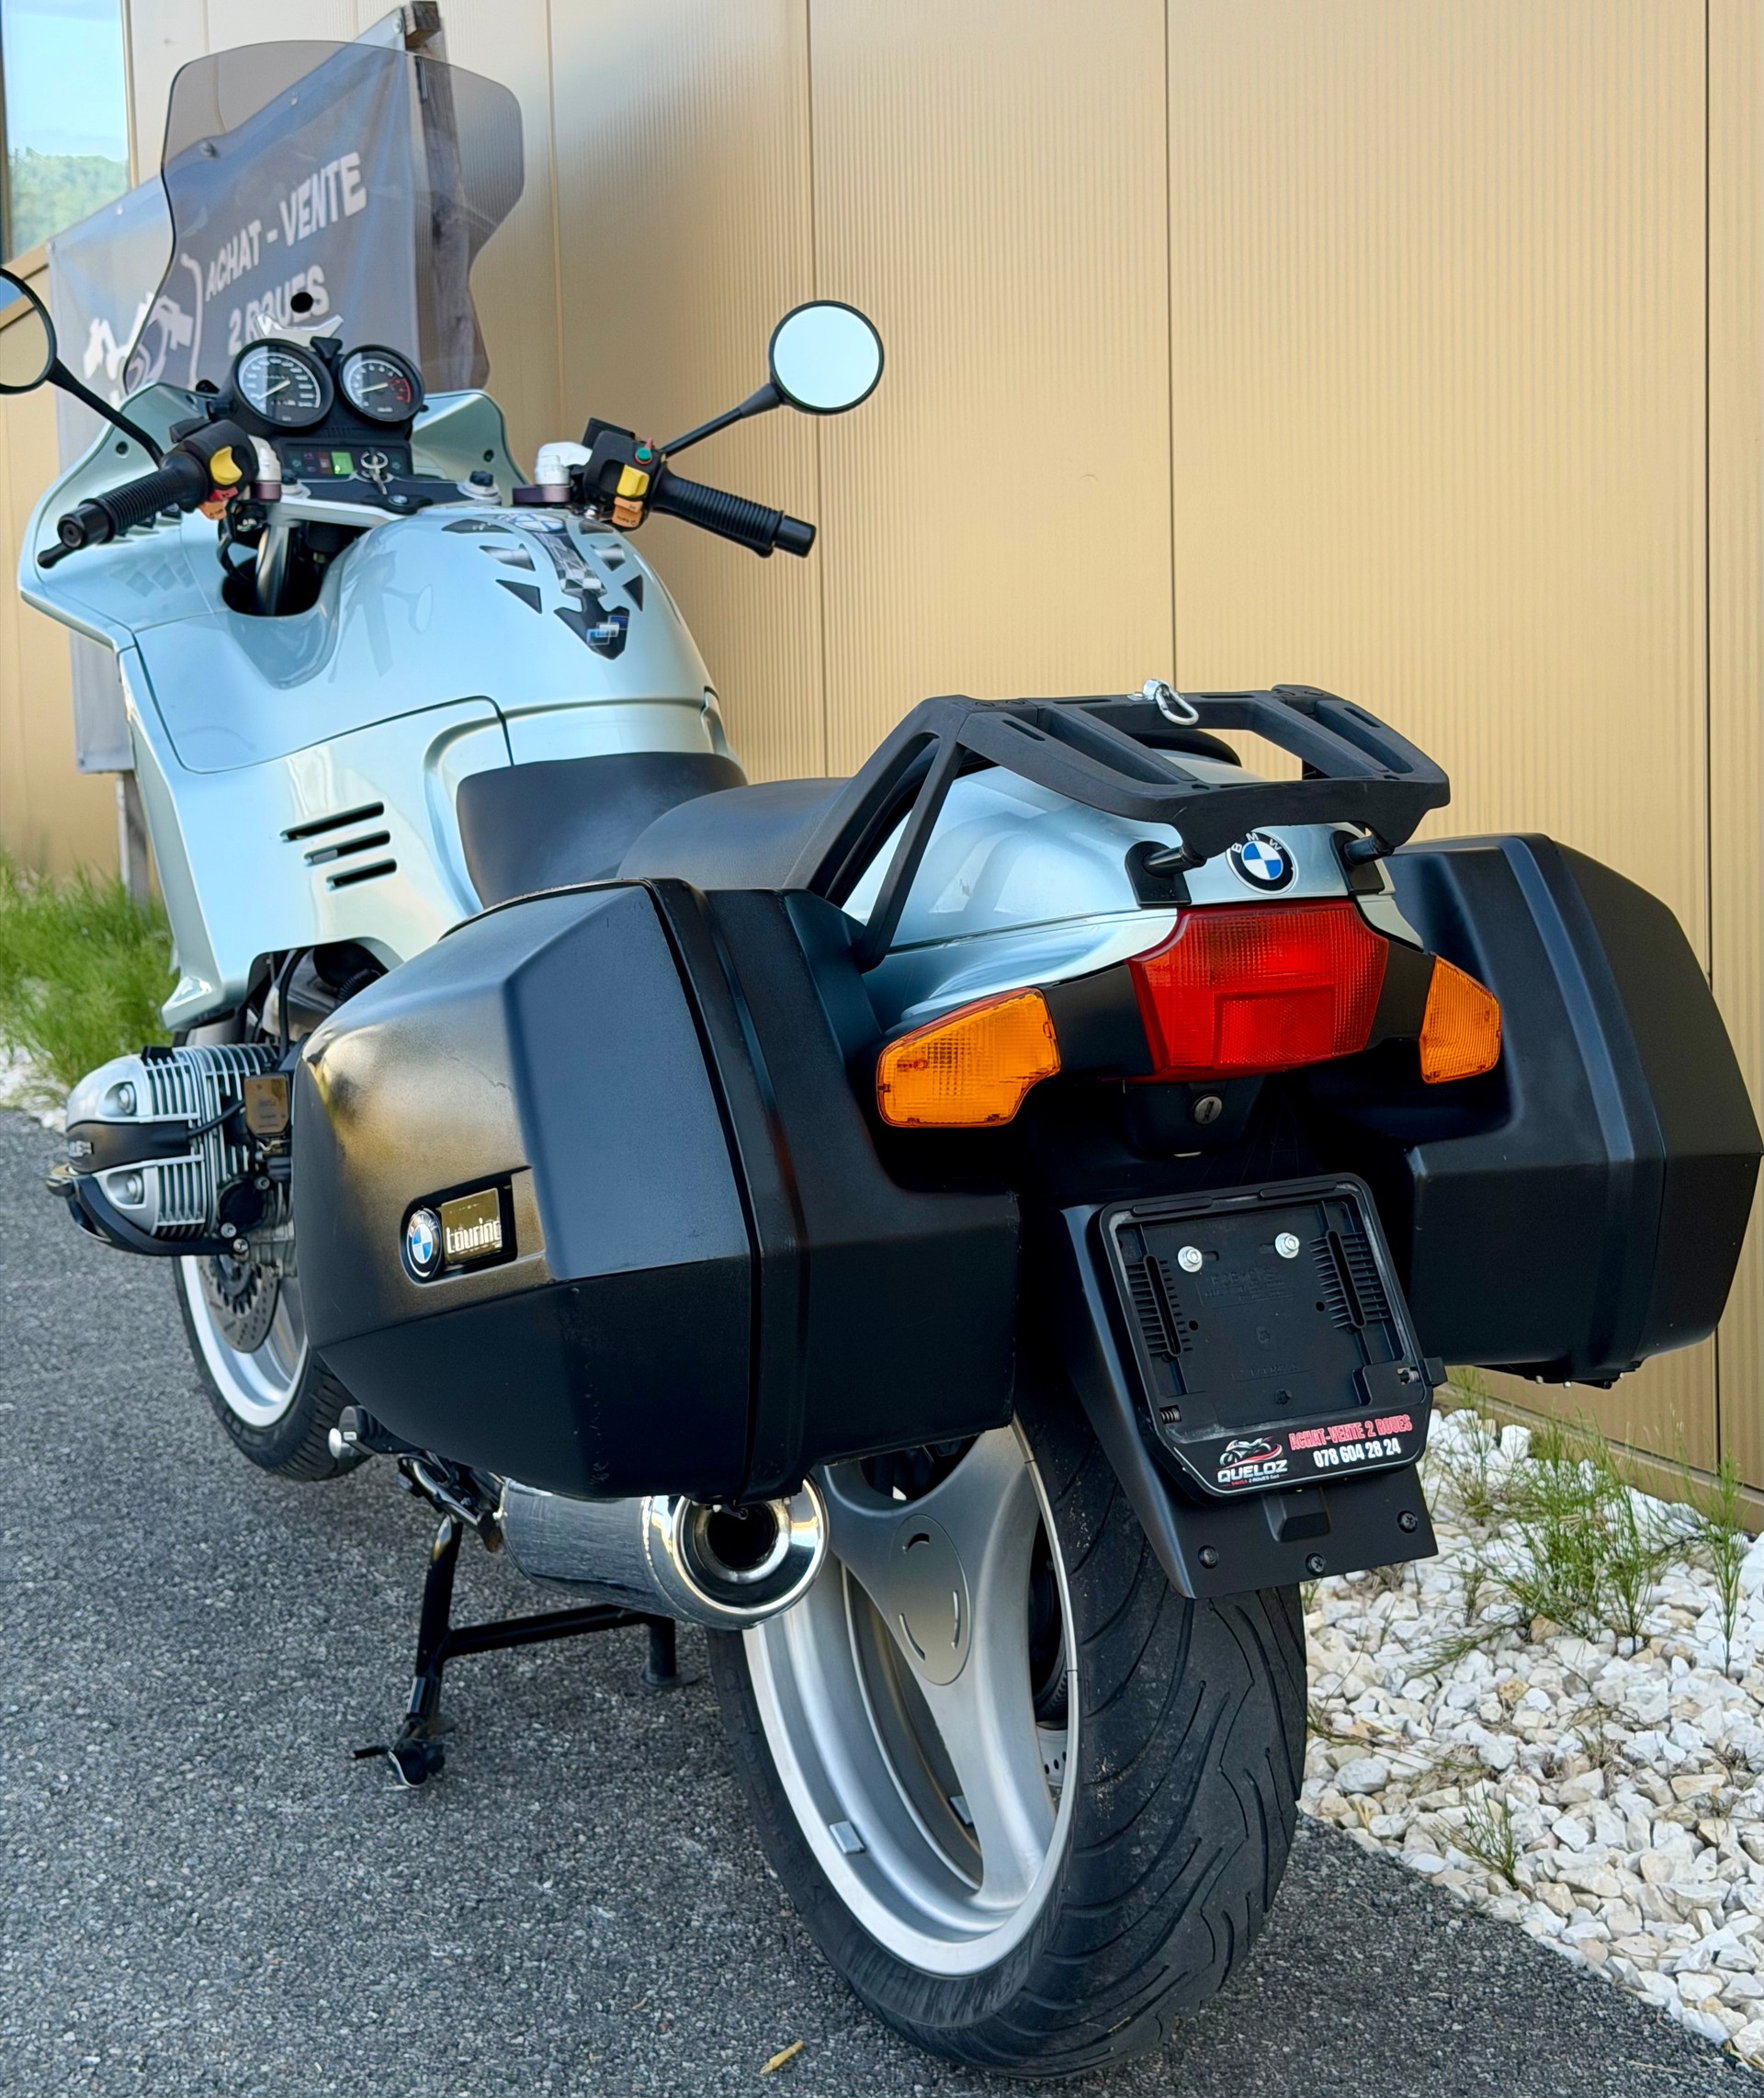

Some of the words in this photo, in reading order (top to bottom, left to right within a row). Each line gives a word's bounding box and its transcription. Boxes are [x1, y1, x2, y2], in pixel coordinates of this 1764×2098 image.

[205, 220, 262, 301] ACHAT
[279, 152, 367, 246] VENTE
[228, 308, 243, 357] 2
[1231, 833, 1283, 854] BMW
[1289, 1422, 1365, 1451] ACHAT-VENTE
[1364, 1420, 1377, 1438] 2
[1374, 1414, 1412, 1435] ROUES
[1313, 1448, 1340, 1469] 078
[1340, 1444, 1365, 1464] 604
[1365, 1440, 1384, 1459] 28
[1384, 1437, 1401, 1456] 24
[1217, 1459, 1288, 1483] QUELOZ
